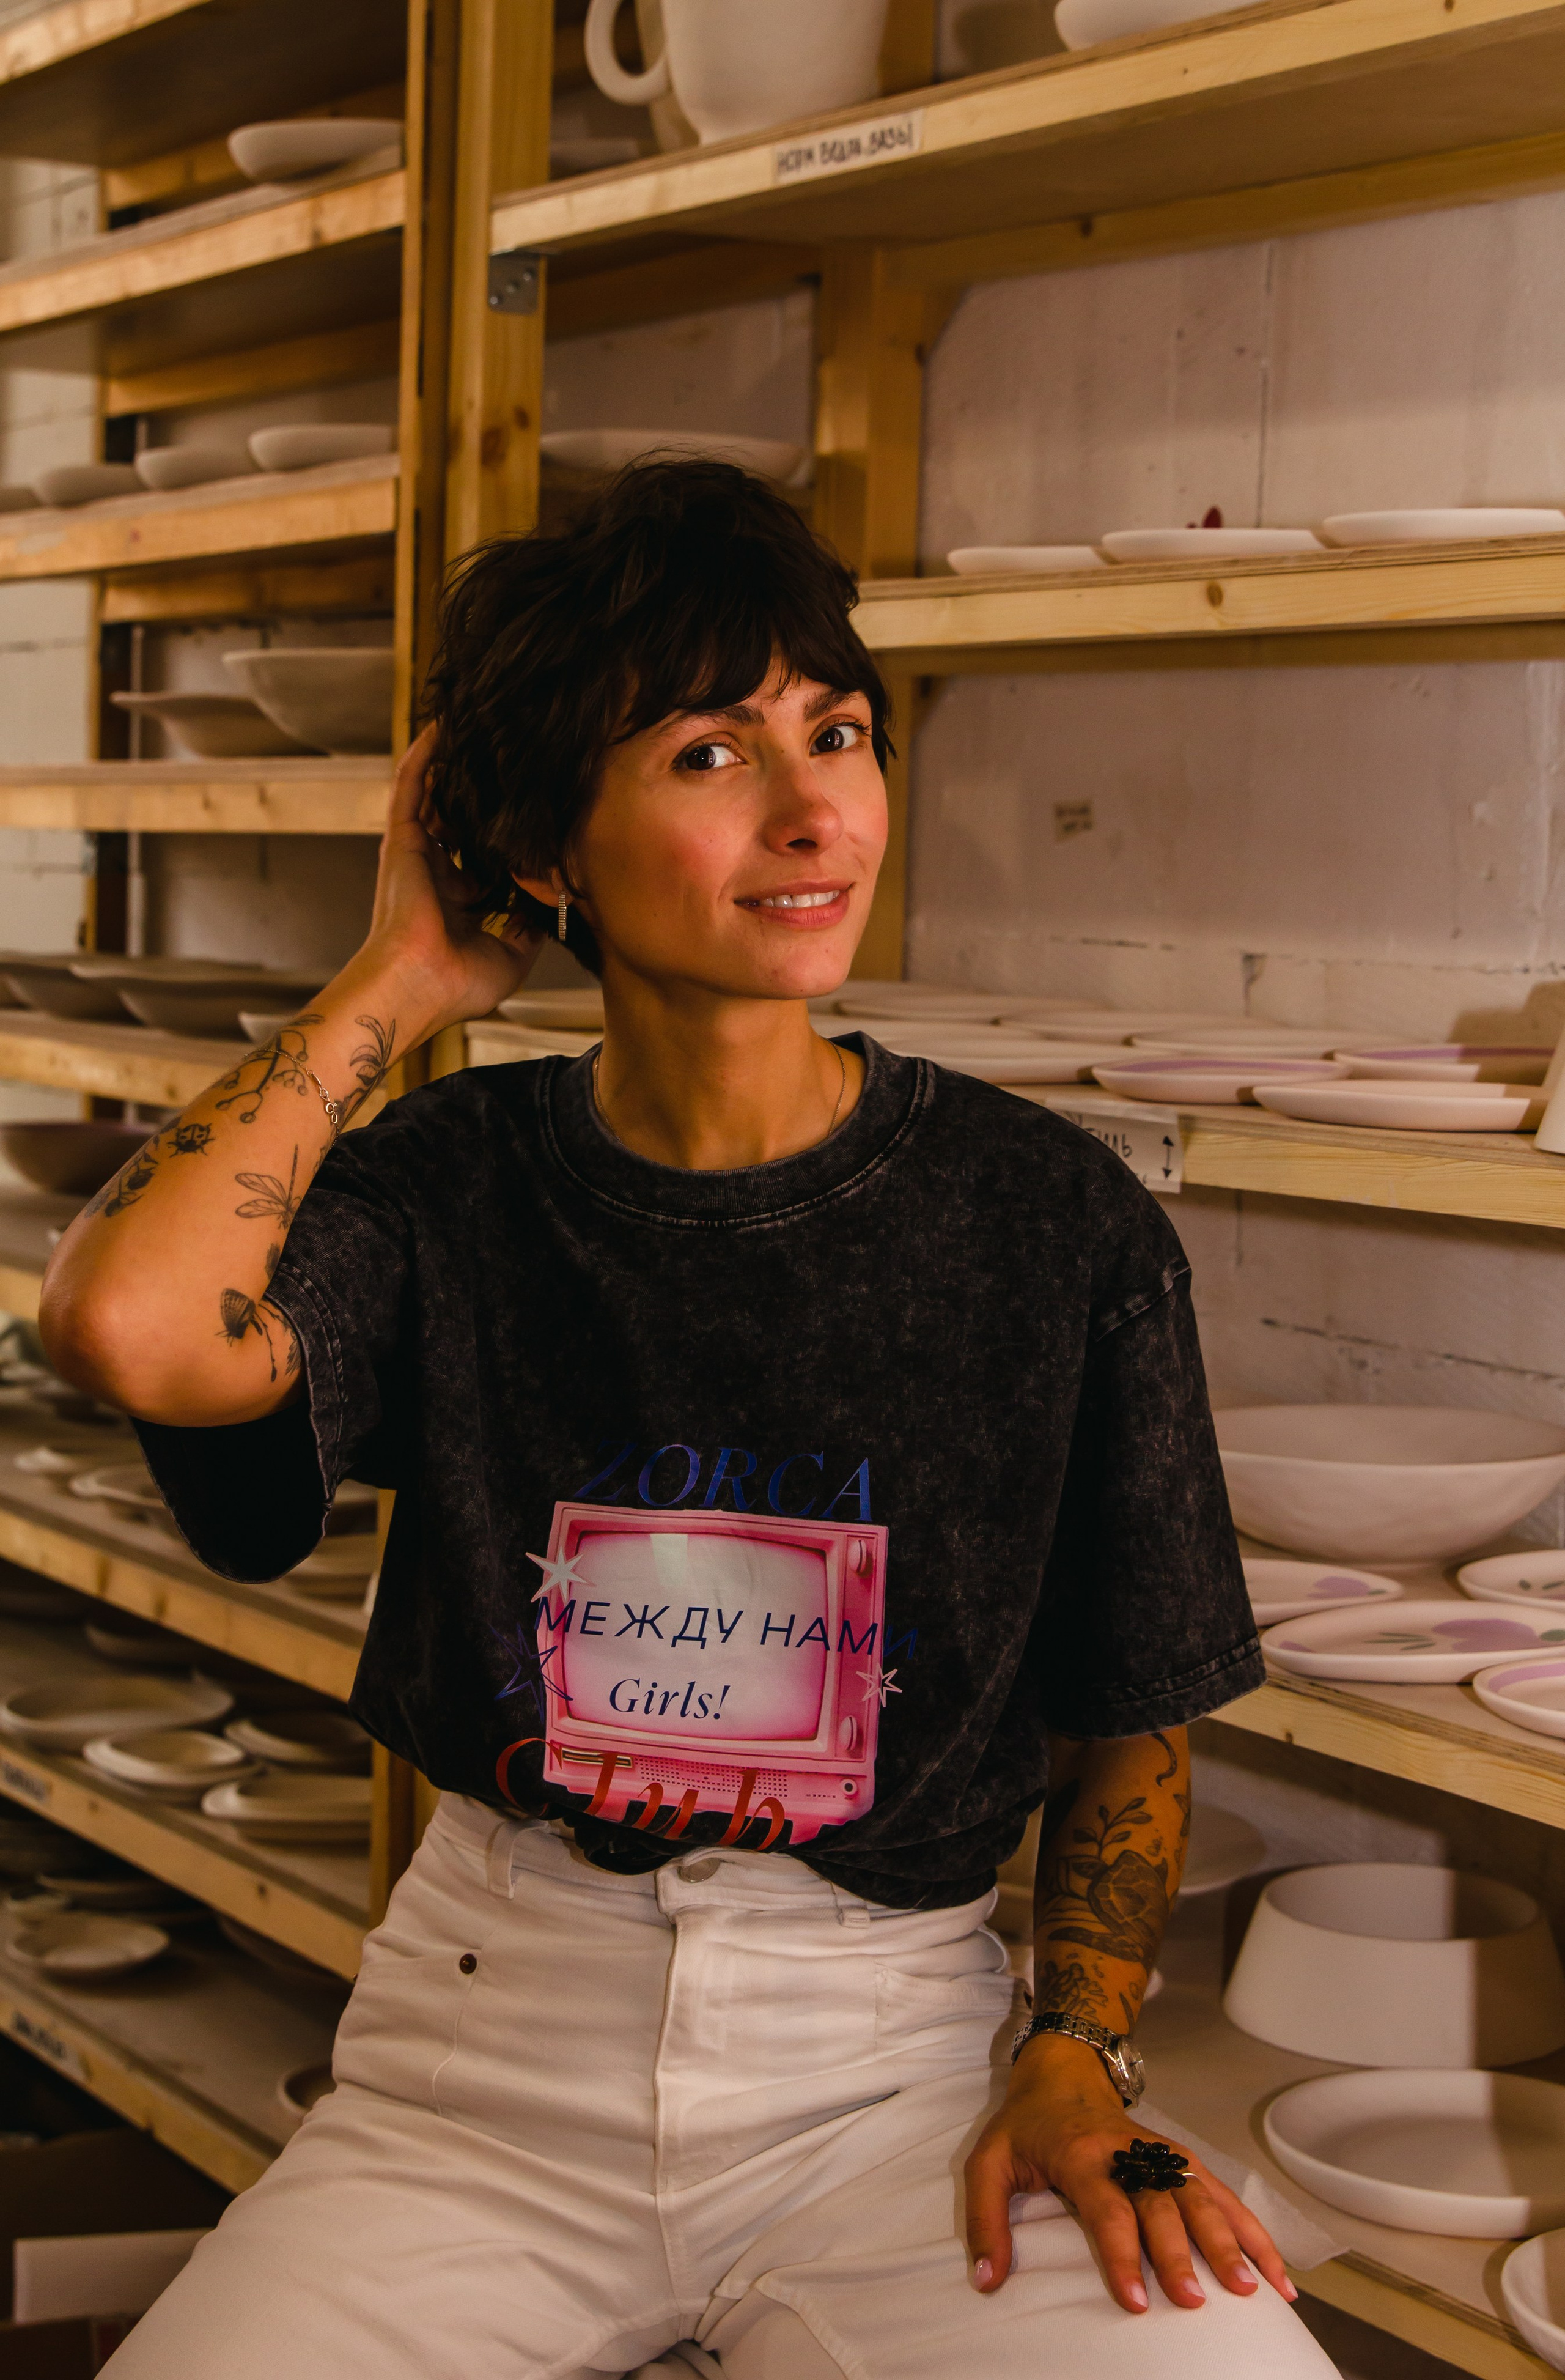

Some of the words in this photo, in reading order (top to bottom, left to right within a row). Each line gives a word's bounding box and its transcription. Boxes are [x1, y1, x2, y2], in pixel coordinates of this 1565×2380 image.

[573, 1438, 872, 1521] ZORCA
[534, 1596, 743, 1649] МЕЖДУ
[760, 1611, 918, 1660] НАМИ
[609, 1677, 731, 1720] Girls!
[495, 1737, 786, 1852] Club
